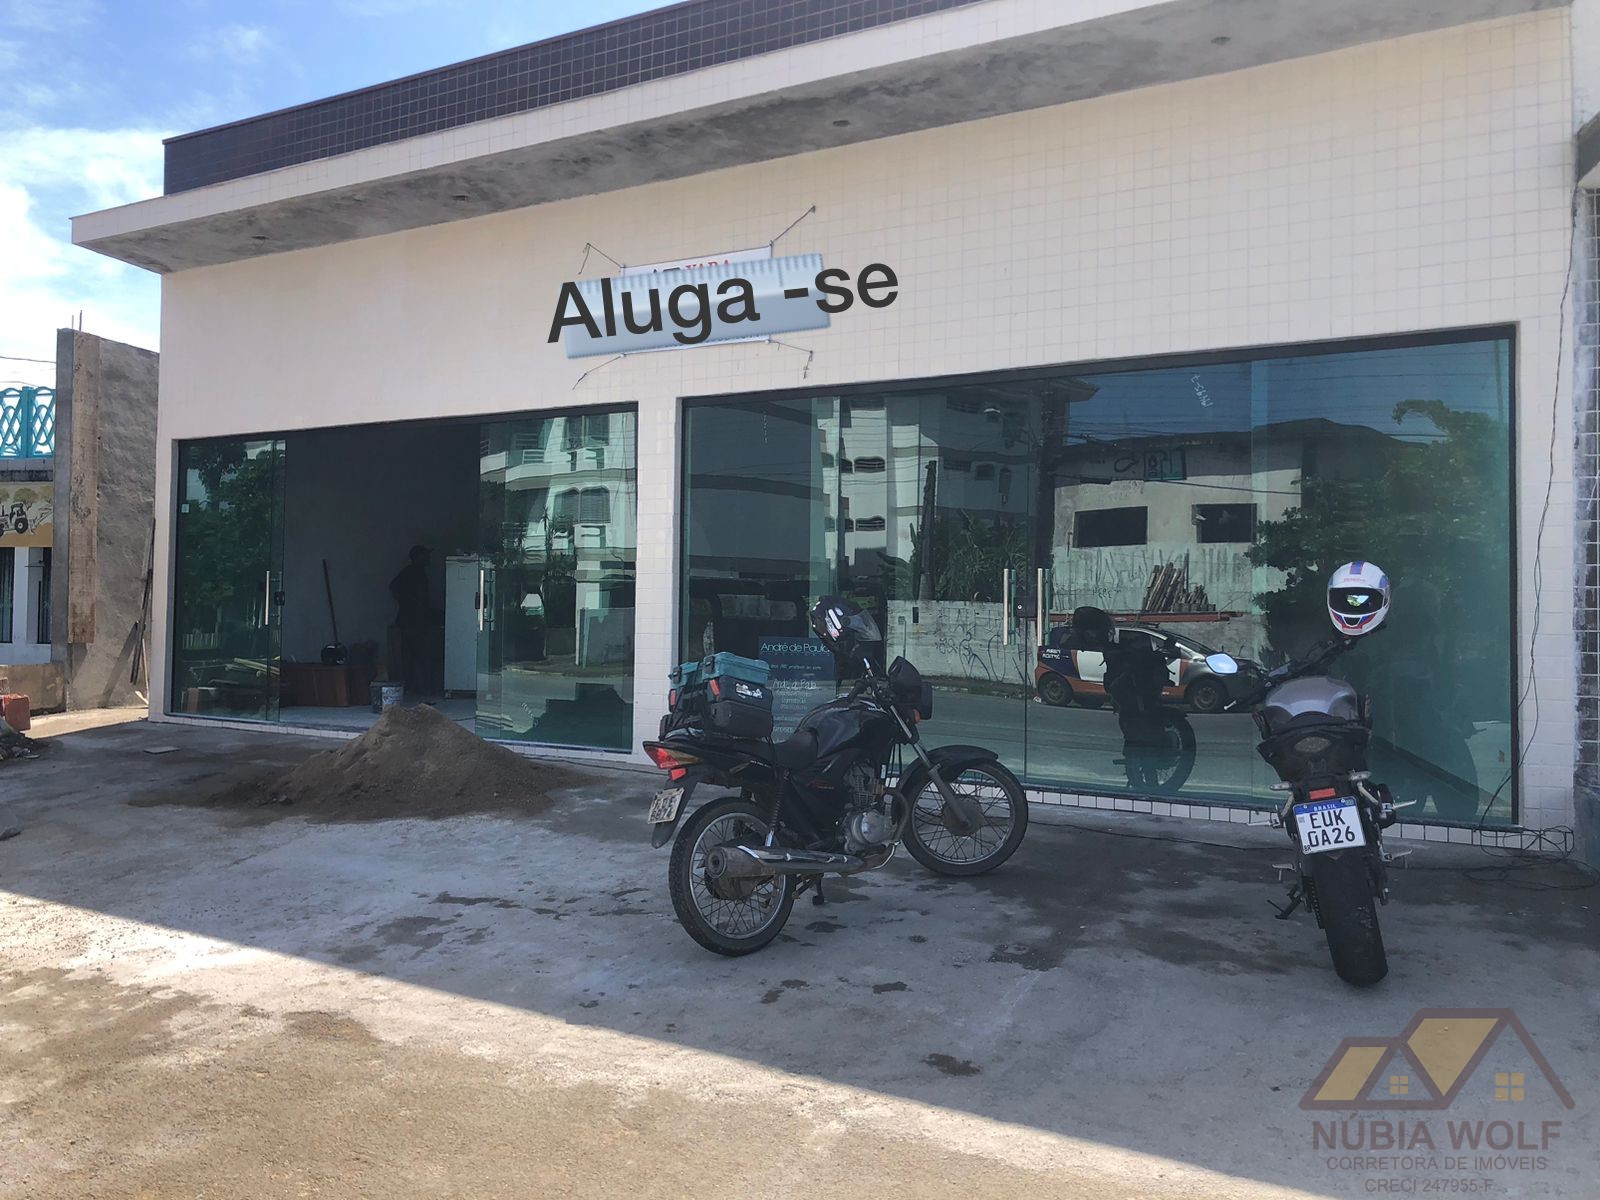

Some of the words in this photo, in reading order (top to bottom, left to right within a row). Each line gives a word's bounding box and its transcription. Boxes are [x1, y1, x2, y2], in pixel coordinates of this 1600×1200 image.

[760, 642, 789, 651] André
[789, 643, 803, 652] de
[1313, 804, 1336, 812] BRASIL
[1310, 809, 1345, 828] EUK
